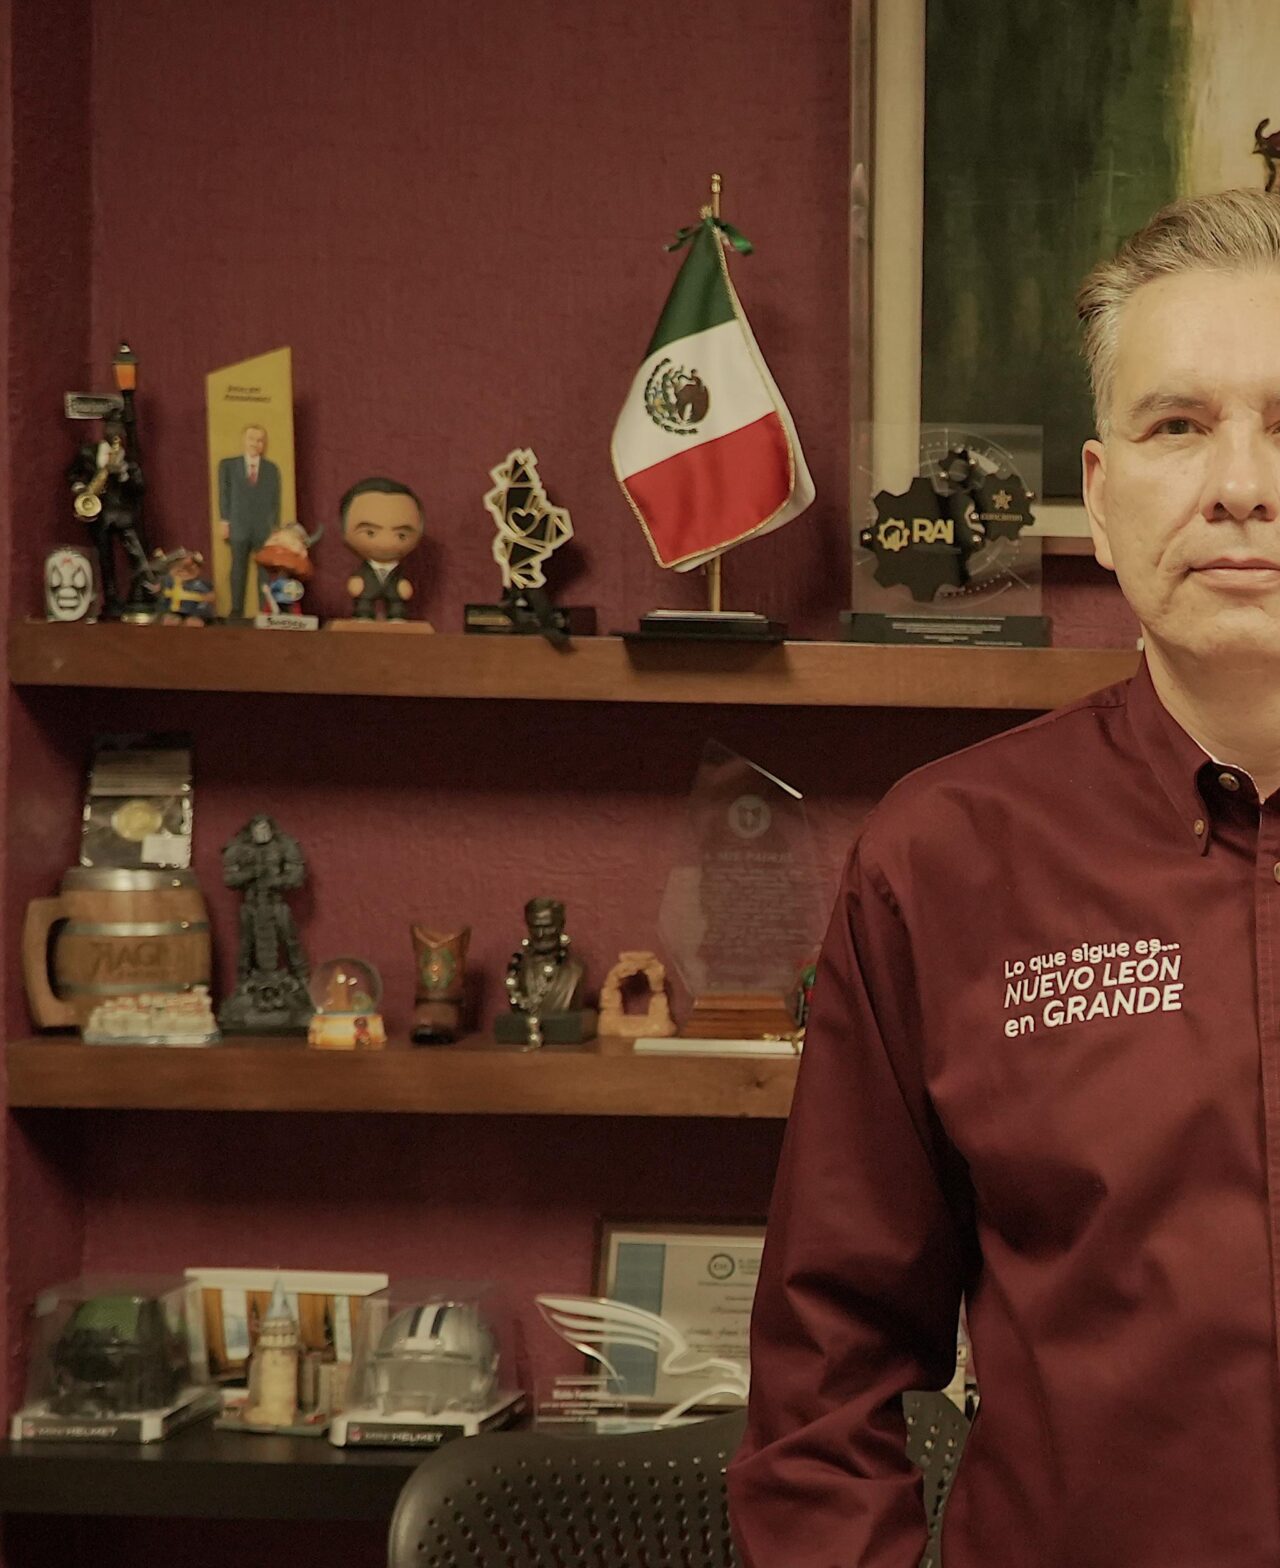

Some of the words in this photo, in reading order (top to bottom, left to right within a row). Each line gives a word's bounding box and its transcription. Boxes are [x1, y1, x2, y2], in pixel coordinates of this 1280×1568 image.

[912, 517, 955, 545] RAI
[1003, 968, 1095, 1008] NUEVO
[1102, 951, 1182, 987] LEÓN
[1004, 961, 1025, 979] Lo
[1029, 951, 1066, 974] que
[1071, 943, 1130, 963] sigue
[1004, 1014, 1035, 1038] en
[1042, 983, 1184, 1028] GRANDE
